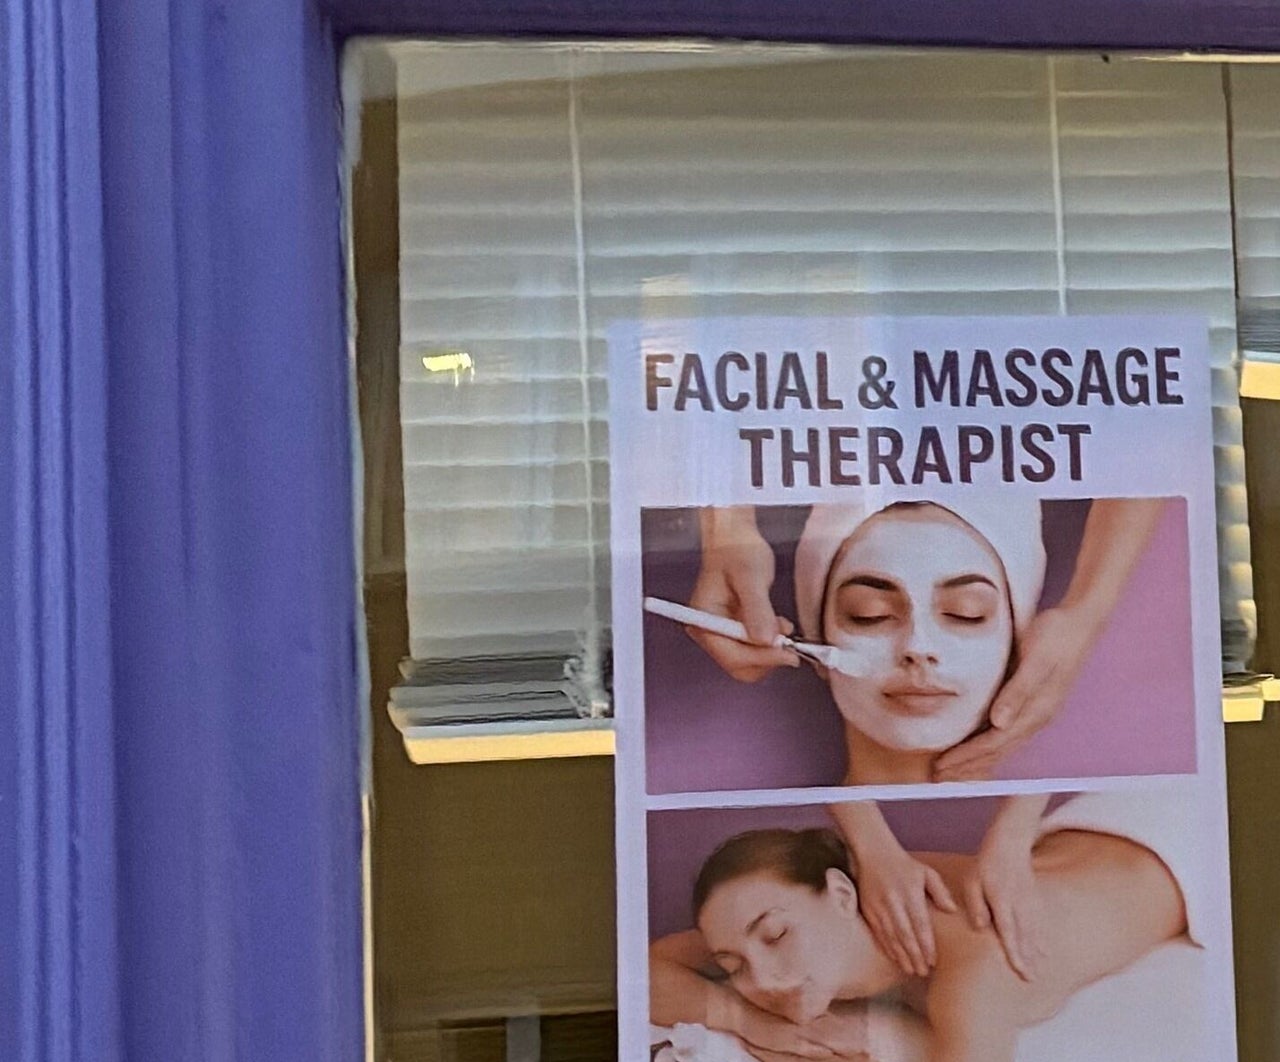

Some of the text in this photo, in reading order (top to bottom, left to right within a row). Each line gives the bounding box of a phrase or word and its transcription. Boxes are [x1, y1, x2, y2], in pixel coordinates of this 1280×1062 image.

[641, 347, 1185, 412] FACIAL & MASSAGE
[738, 423, 1092, 488] THERAPIST
